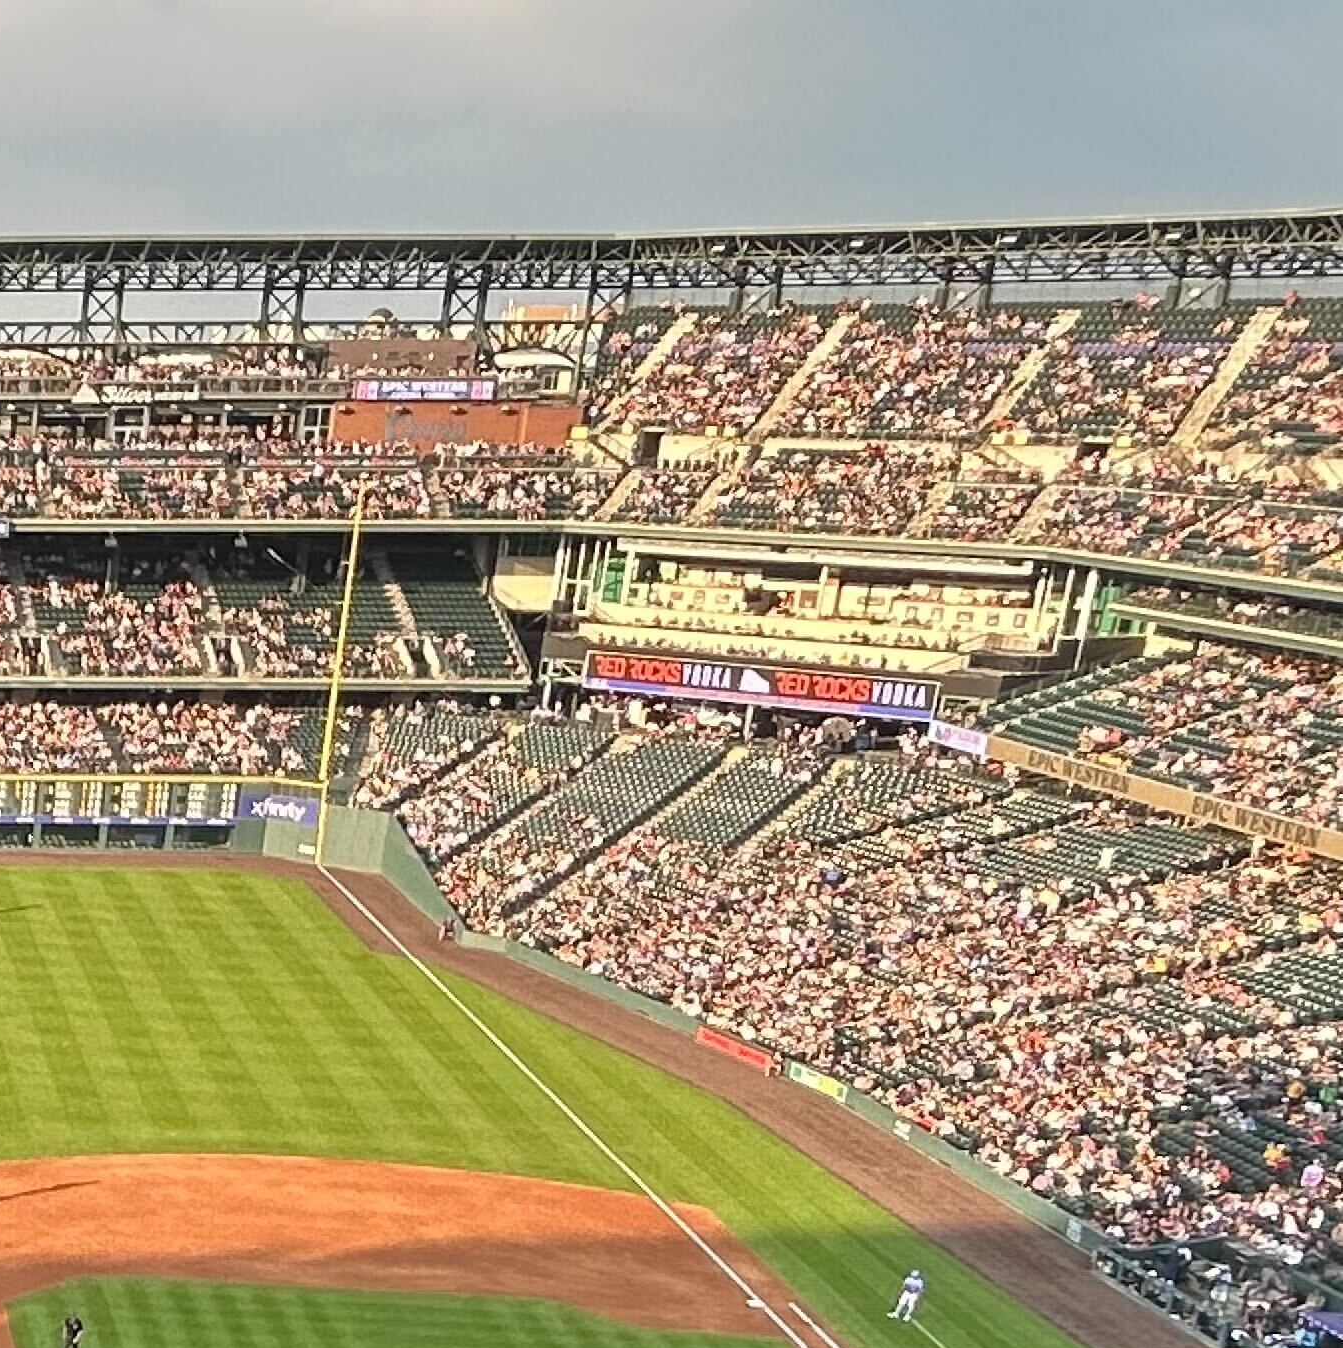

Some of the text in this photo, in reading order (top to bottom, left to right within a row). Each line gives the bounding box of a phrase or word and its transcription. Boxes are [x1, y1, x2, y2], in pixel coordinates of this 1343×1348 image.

[596, 655, 927, 709] RED ROCKS VODKA RED ROCKS VODKA
[250, 797, 306, 822] xfinity
[1062, 757, 1131, 793] WESTERN
[1234, 801, 1322, 845] WESTERN
